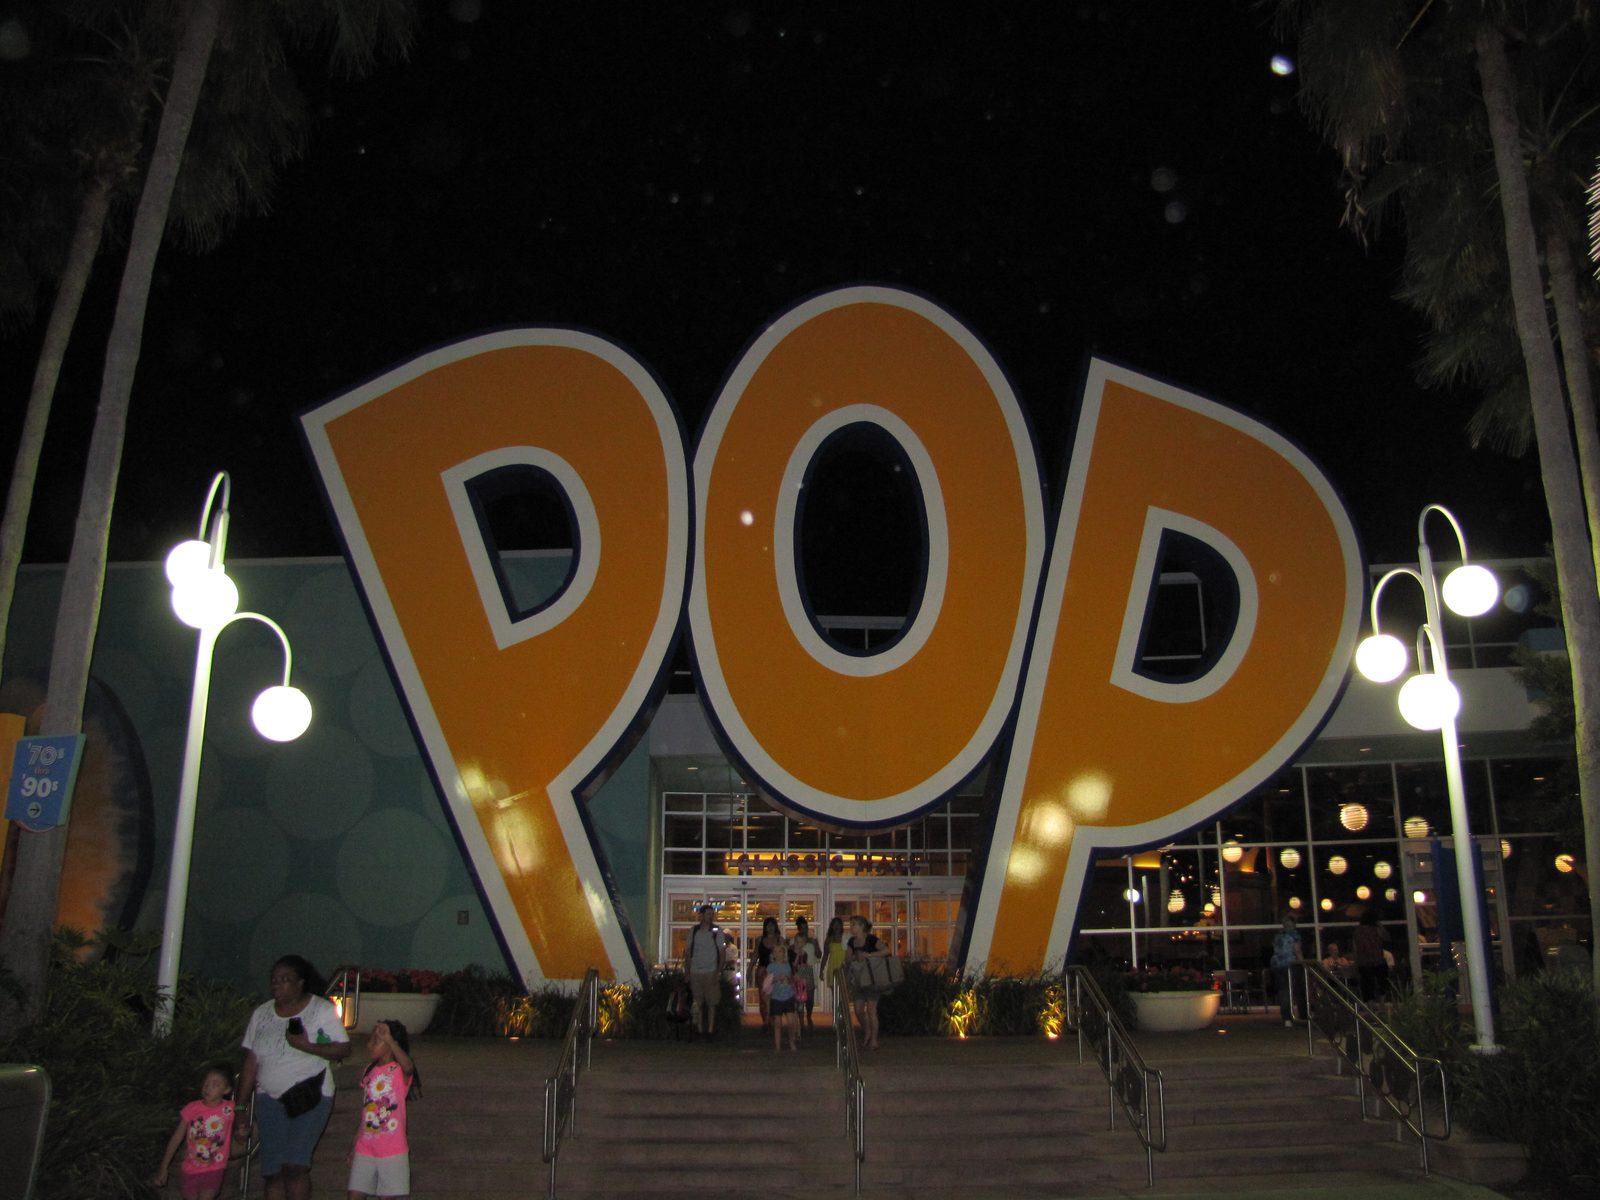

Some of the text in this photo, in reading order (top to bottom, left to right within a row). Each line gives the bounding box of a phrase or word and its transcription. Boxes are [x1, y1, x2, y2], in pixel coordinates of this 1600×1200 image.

[299, 284, 1366, 993] POP
[738, 853, 921, 873] CLASSIC HALL
